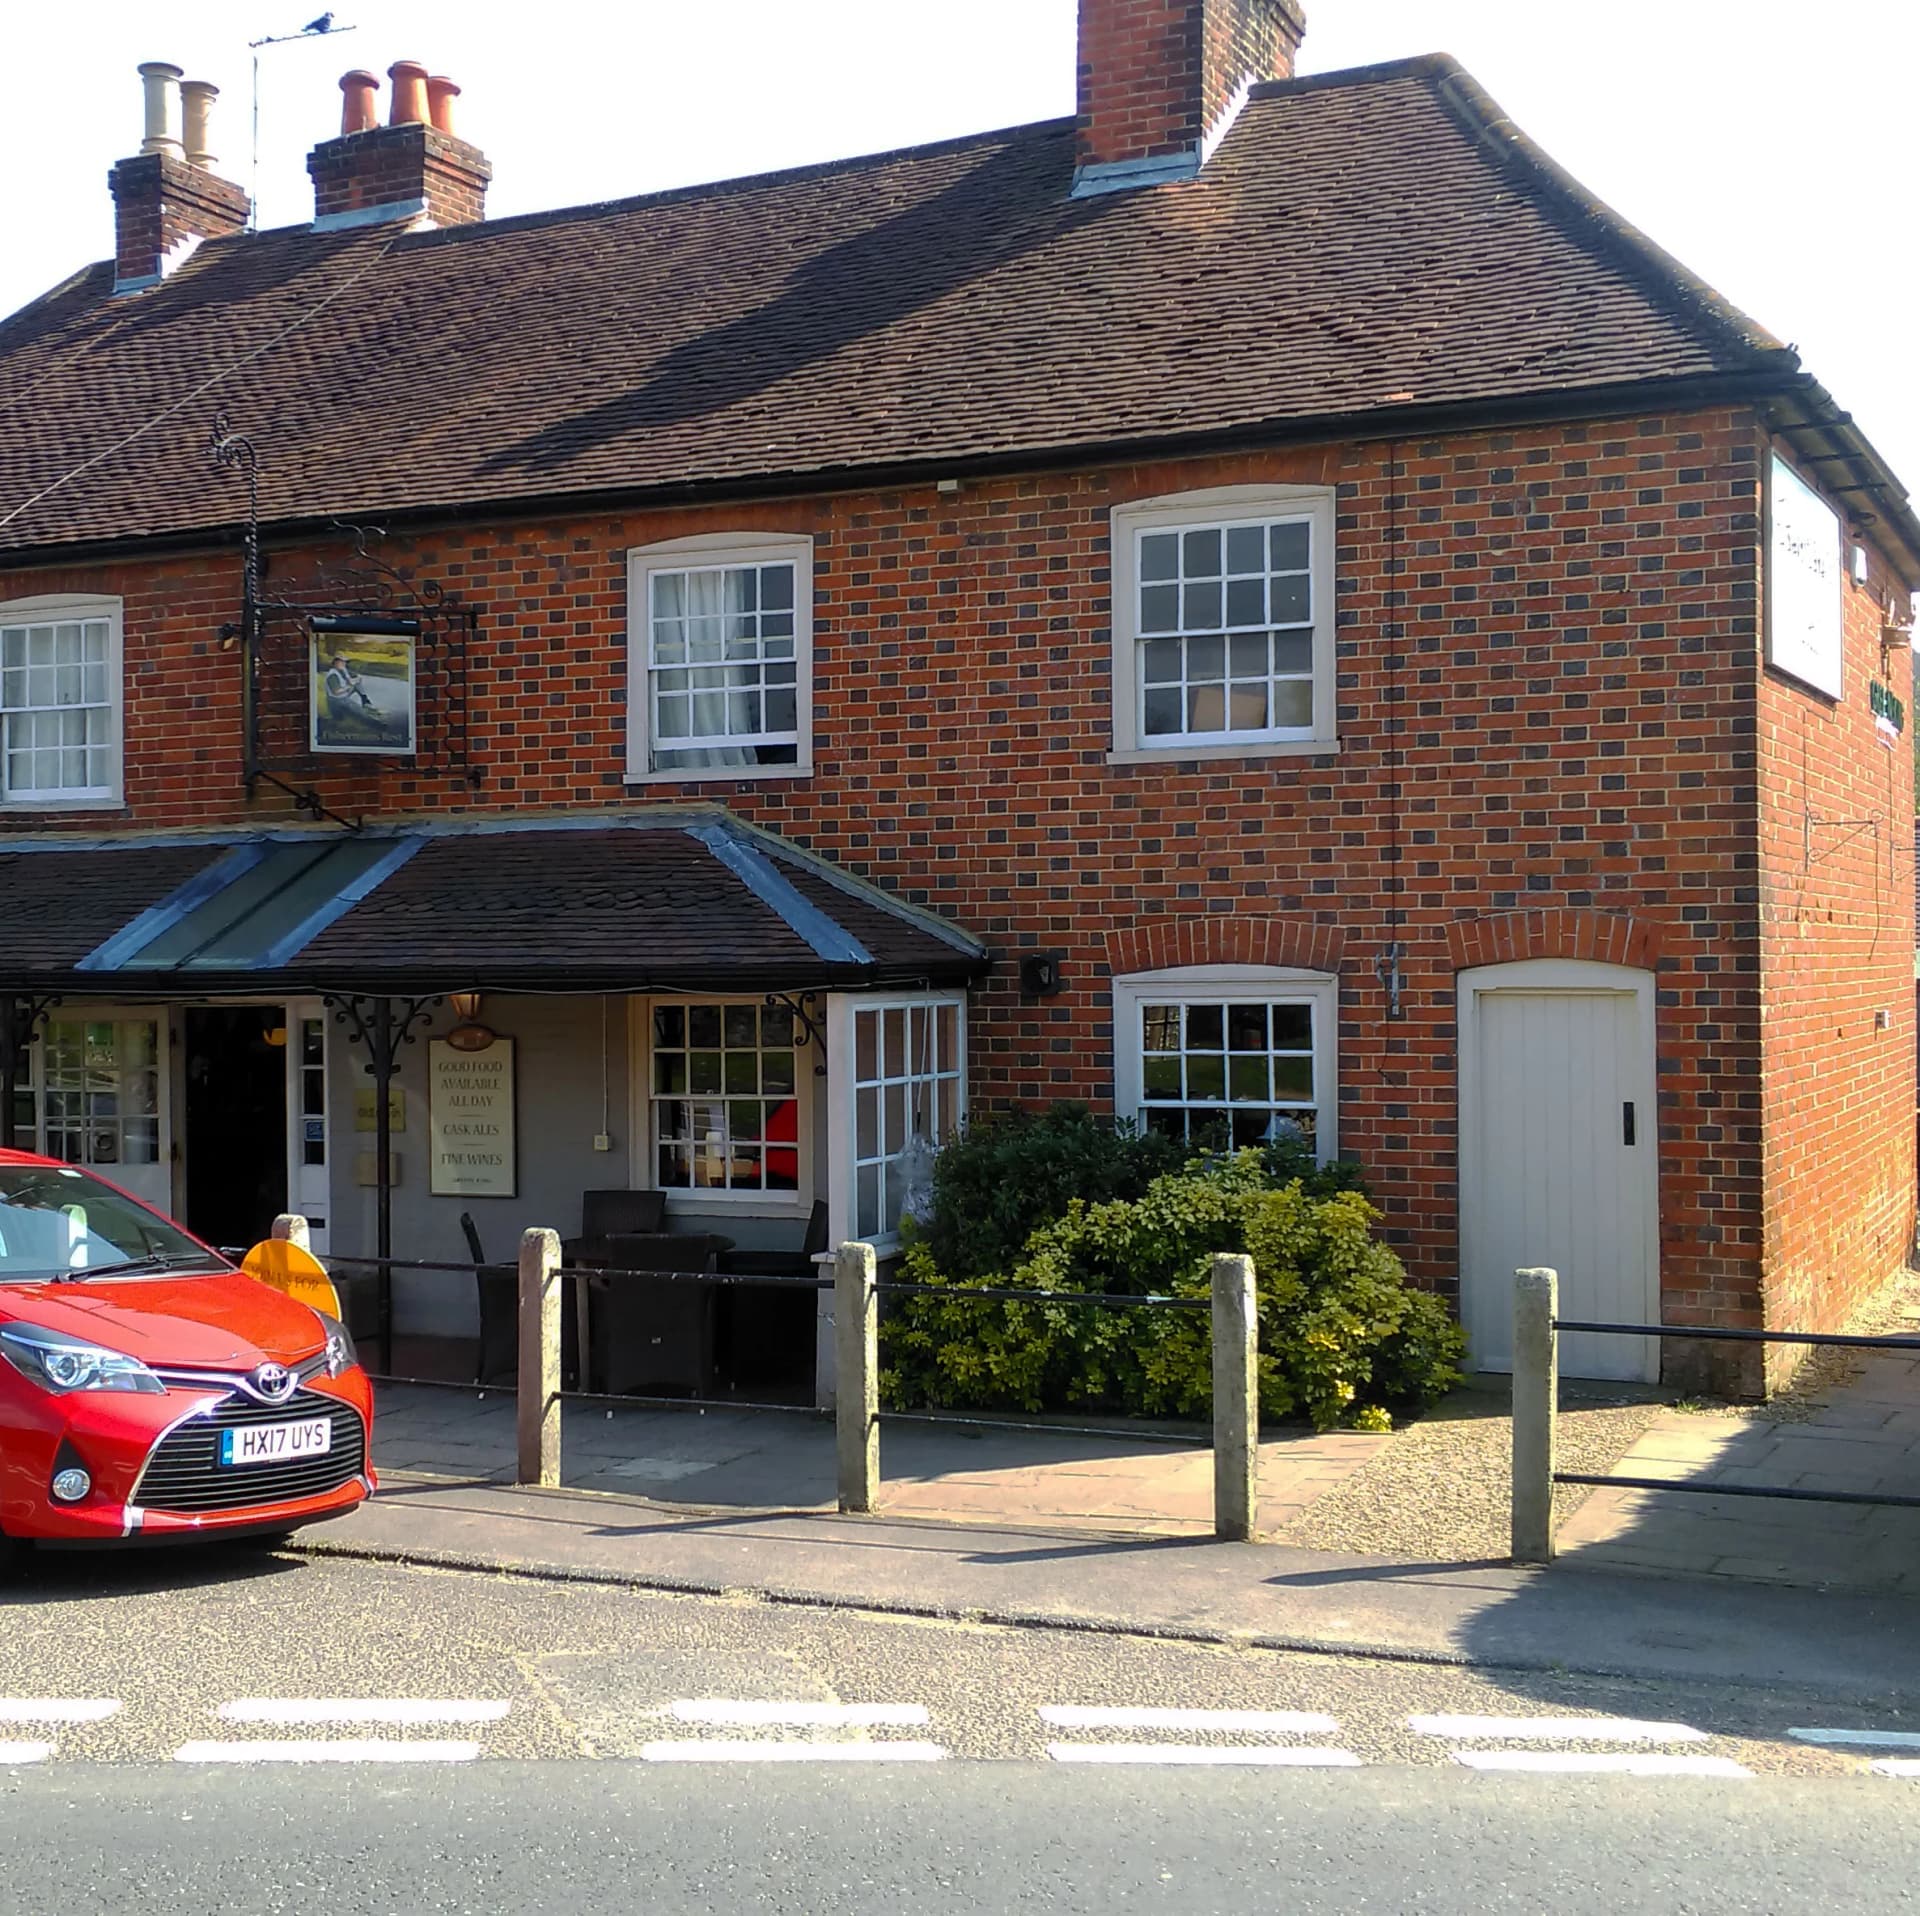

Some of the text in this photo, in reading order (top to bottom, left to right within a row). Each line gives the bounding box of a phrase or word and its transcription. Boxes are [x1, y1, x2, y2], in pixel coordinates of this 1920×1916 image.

[438, 1061, 503, 1073] GOOD FOOD
[441, 1078, 502, 1090] AVAILABLE
[448, 1095, 494, 1107] ALL DAY
[443, 1123, 500, 1136] CASK ALES
[441, 1153, 503, 1166] FINE WINES
[295, 1275, 320, 1292] FOR
[243, 1423, 324, 1457] HX17 UYS
